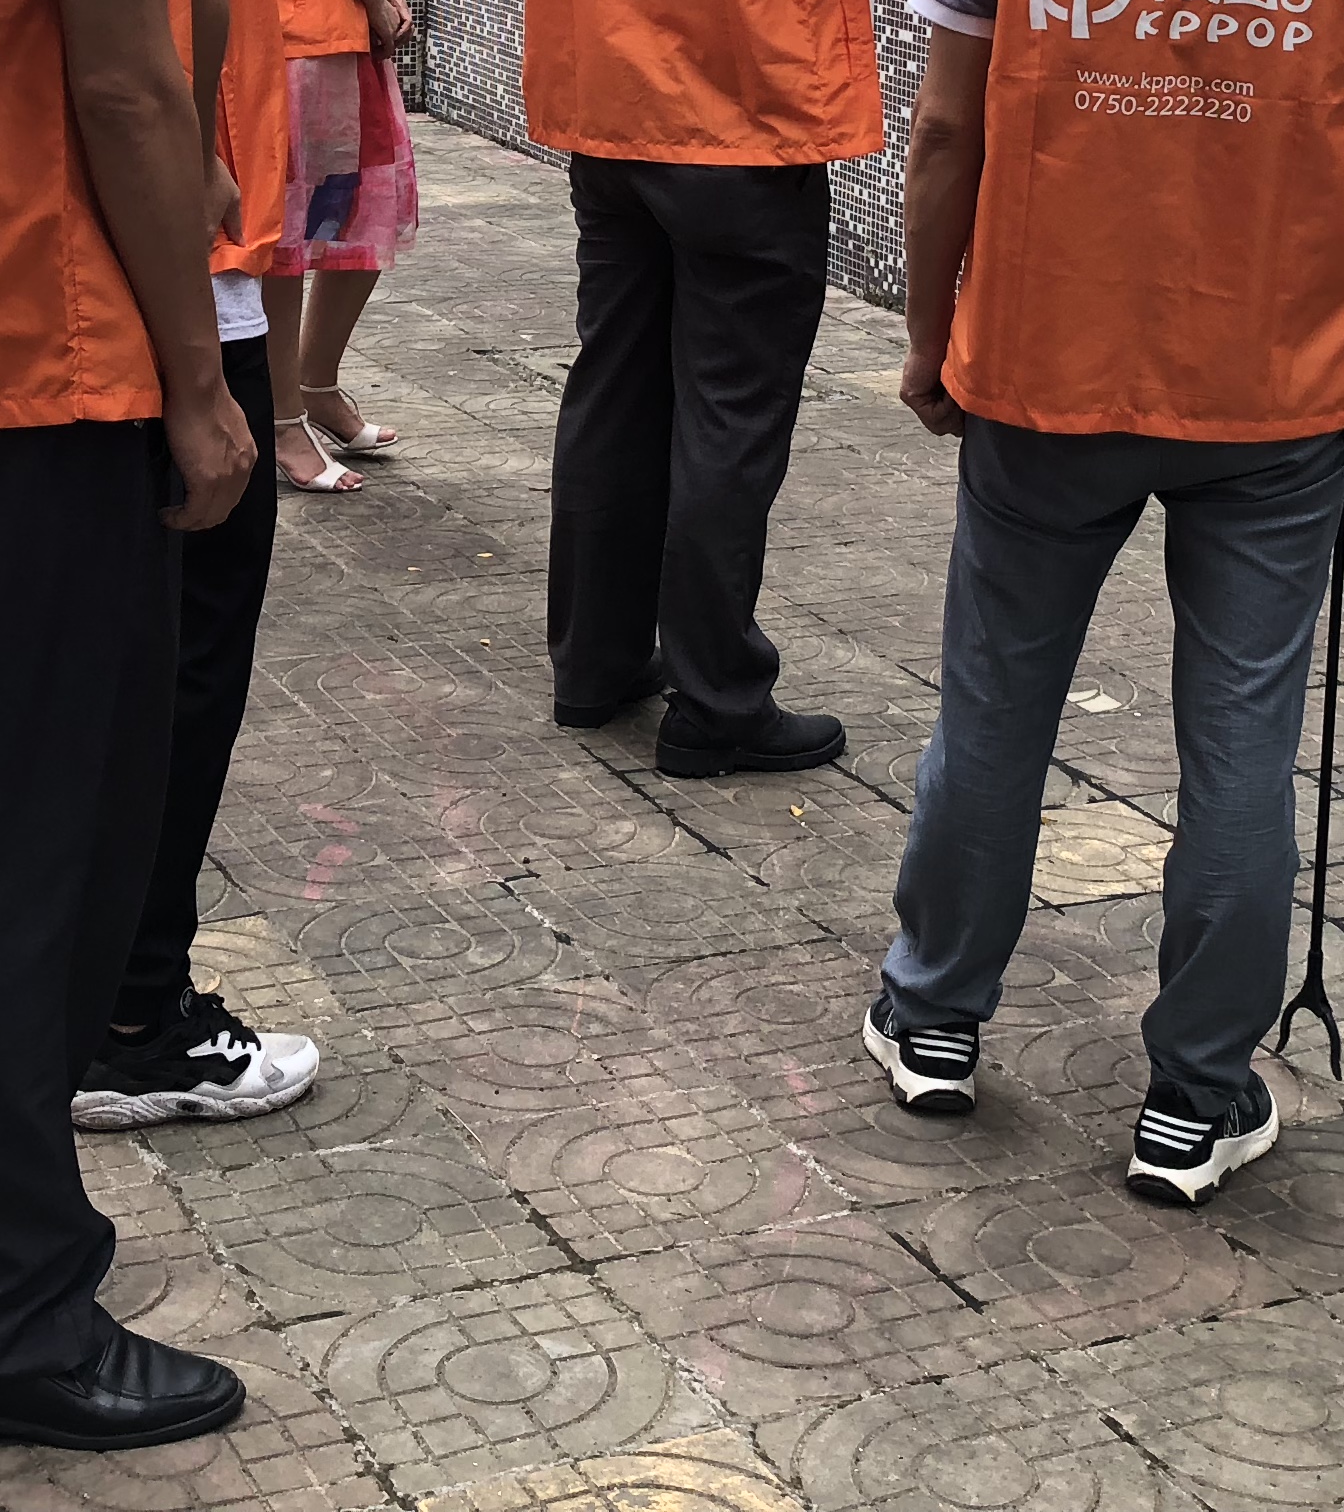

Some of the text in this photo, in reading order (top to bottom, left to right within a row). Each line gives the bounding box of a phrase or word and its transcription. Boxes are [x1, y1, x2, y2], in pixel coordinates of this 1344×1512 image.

[1135, 10, 1313, 51] KPPOP
[1076, 68, 1254, 97] www.kppop.com
[1074, 90, 1252, 124] 0750-2222220
